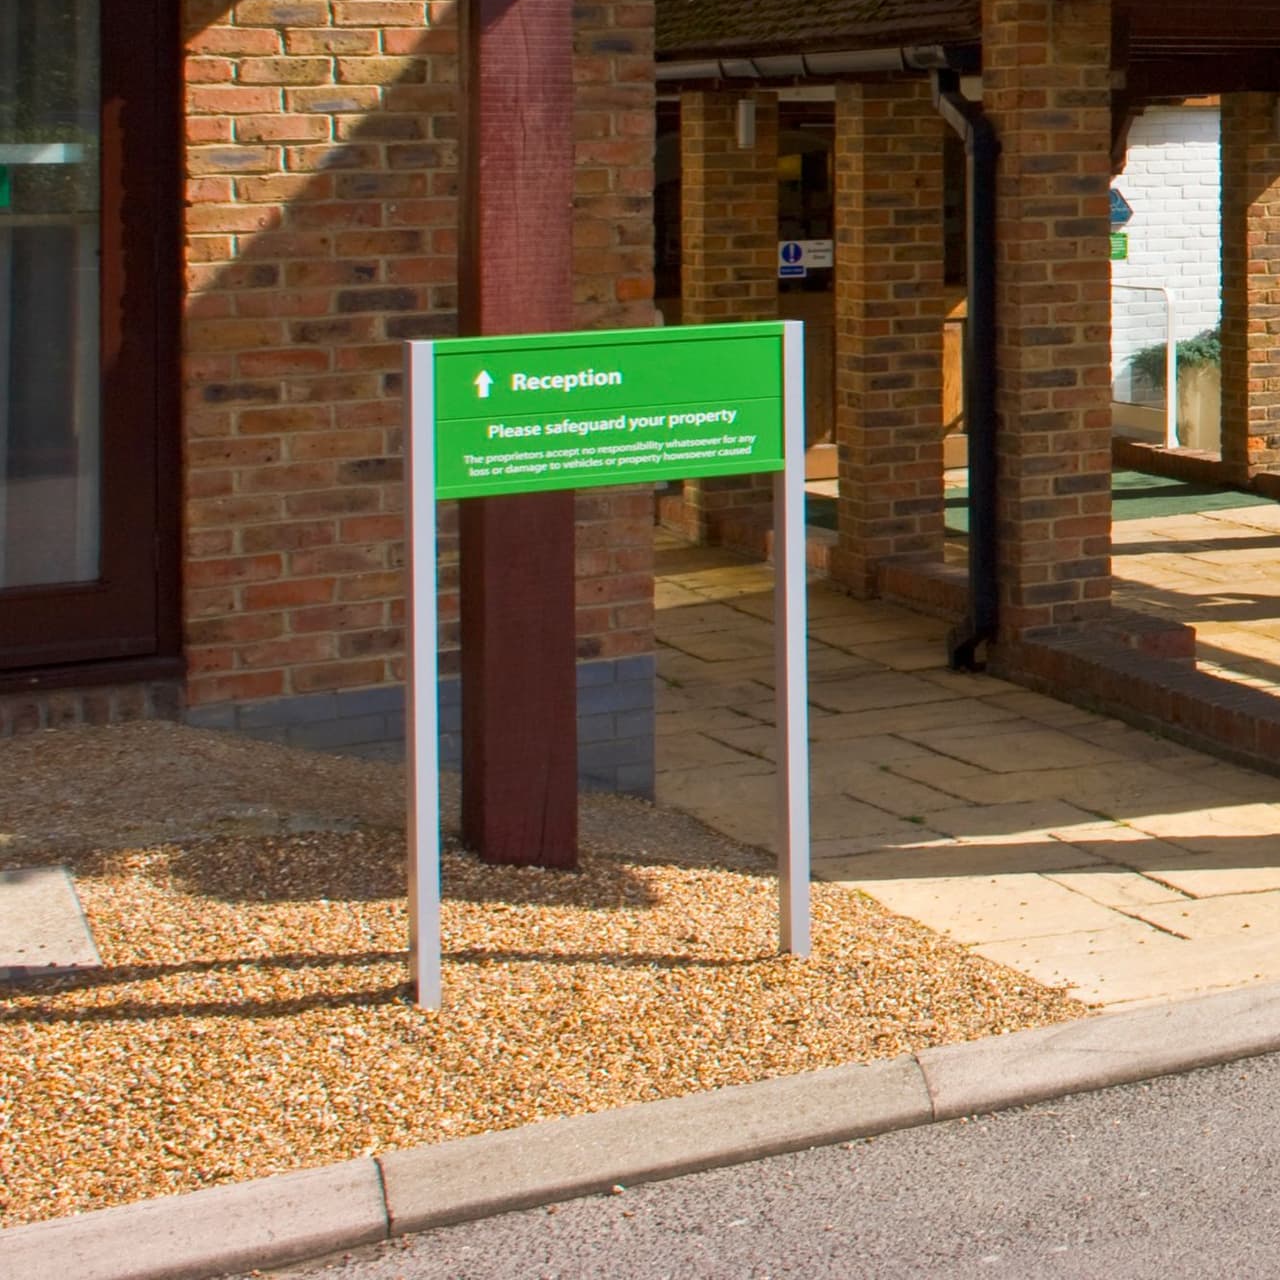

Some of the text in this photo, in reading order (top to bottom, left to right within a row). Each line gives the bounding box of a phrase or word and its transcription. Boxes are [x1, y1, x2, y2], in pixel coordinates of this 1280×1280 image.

[511, 369, 623, 392] Reception
[487, 409, 737, 439] Please safeguard your property
[464, 454, 484, 464] The
[485, 451, 544, 465] proprietors
[545, 448, 580, 458] accept
[597, 441, 664, 454] responsibility
[665, 438, 722, 448] whatsoever
[722, 435, 737, 443] for
[738, 435, 757, 444] any
[468, 446, 752, 477] loss or damage to vehicles or property howsoever caused
